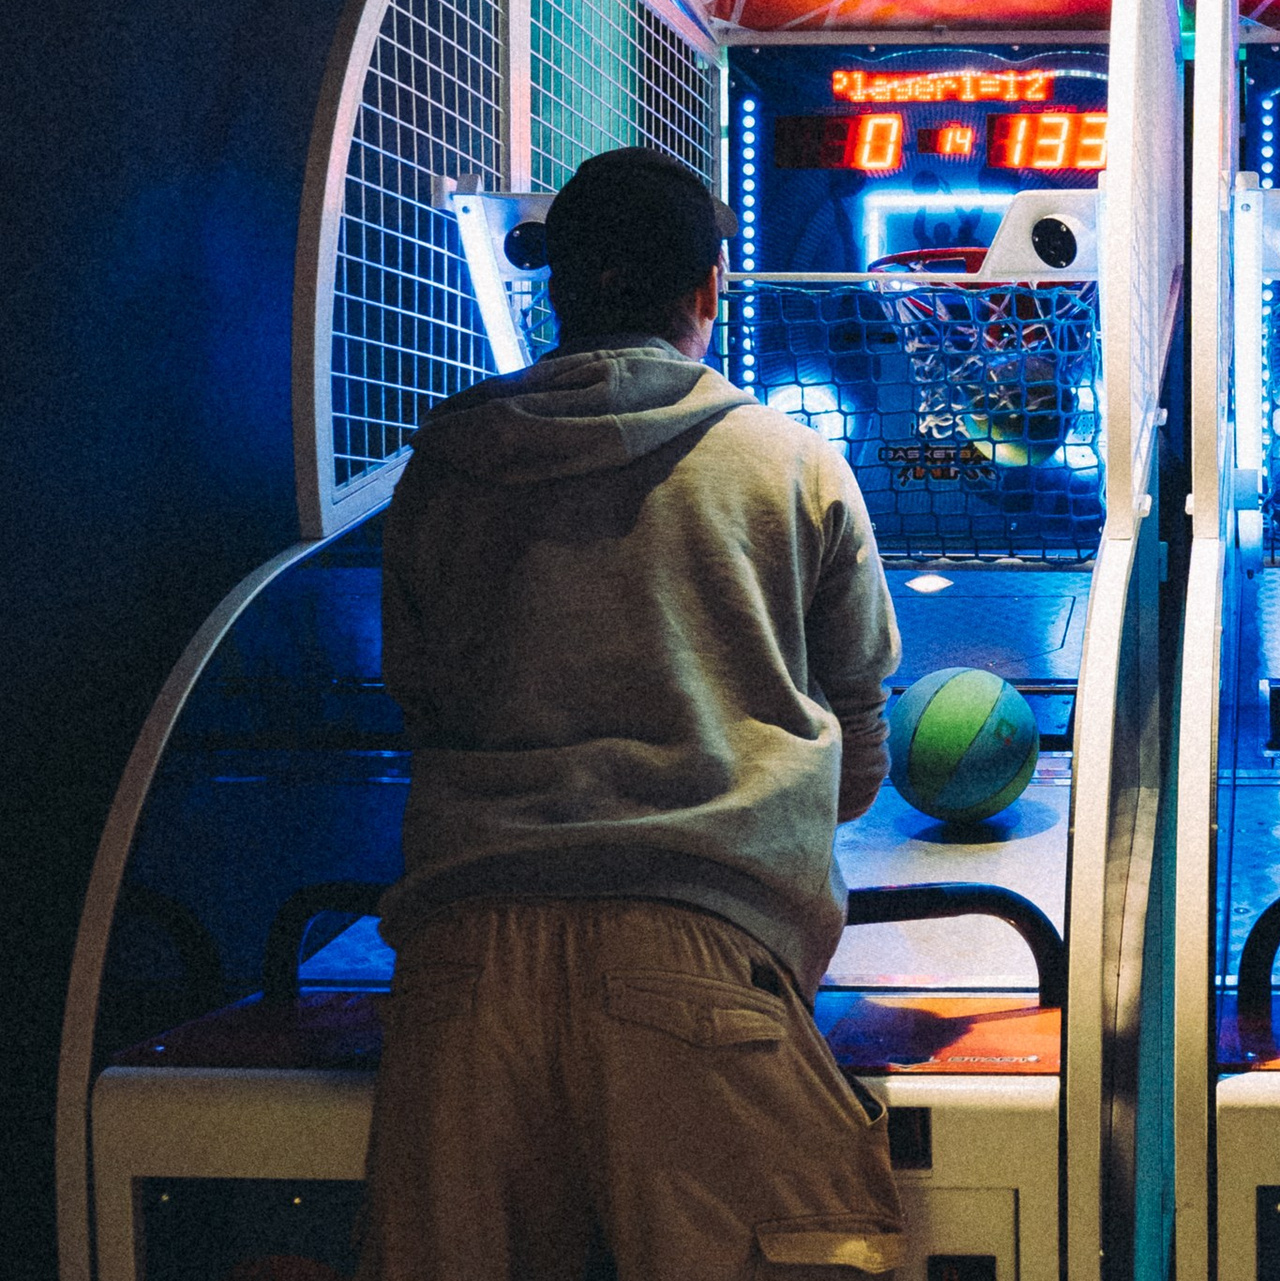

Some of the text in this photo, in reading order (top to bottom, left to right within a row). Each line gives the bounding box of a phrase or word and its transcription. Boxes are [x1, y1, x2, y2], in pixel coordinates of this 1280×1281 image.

[1020, 104, 1078, 114] SCORE
[860, 116, 1107, 168] 0 14 133
